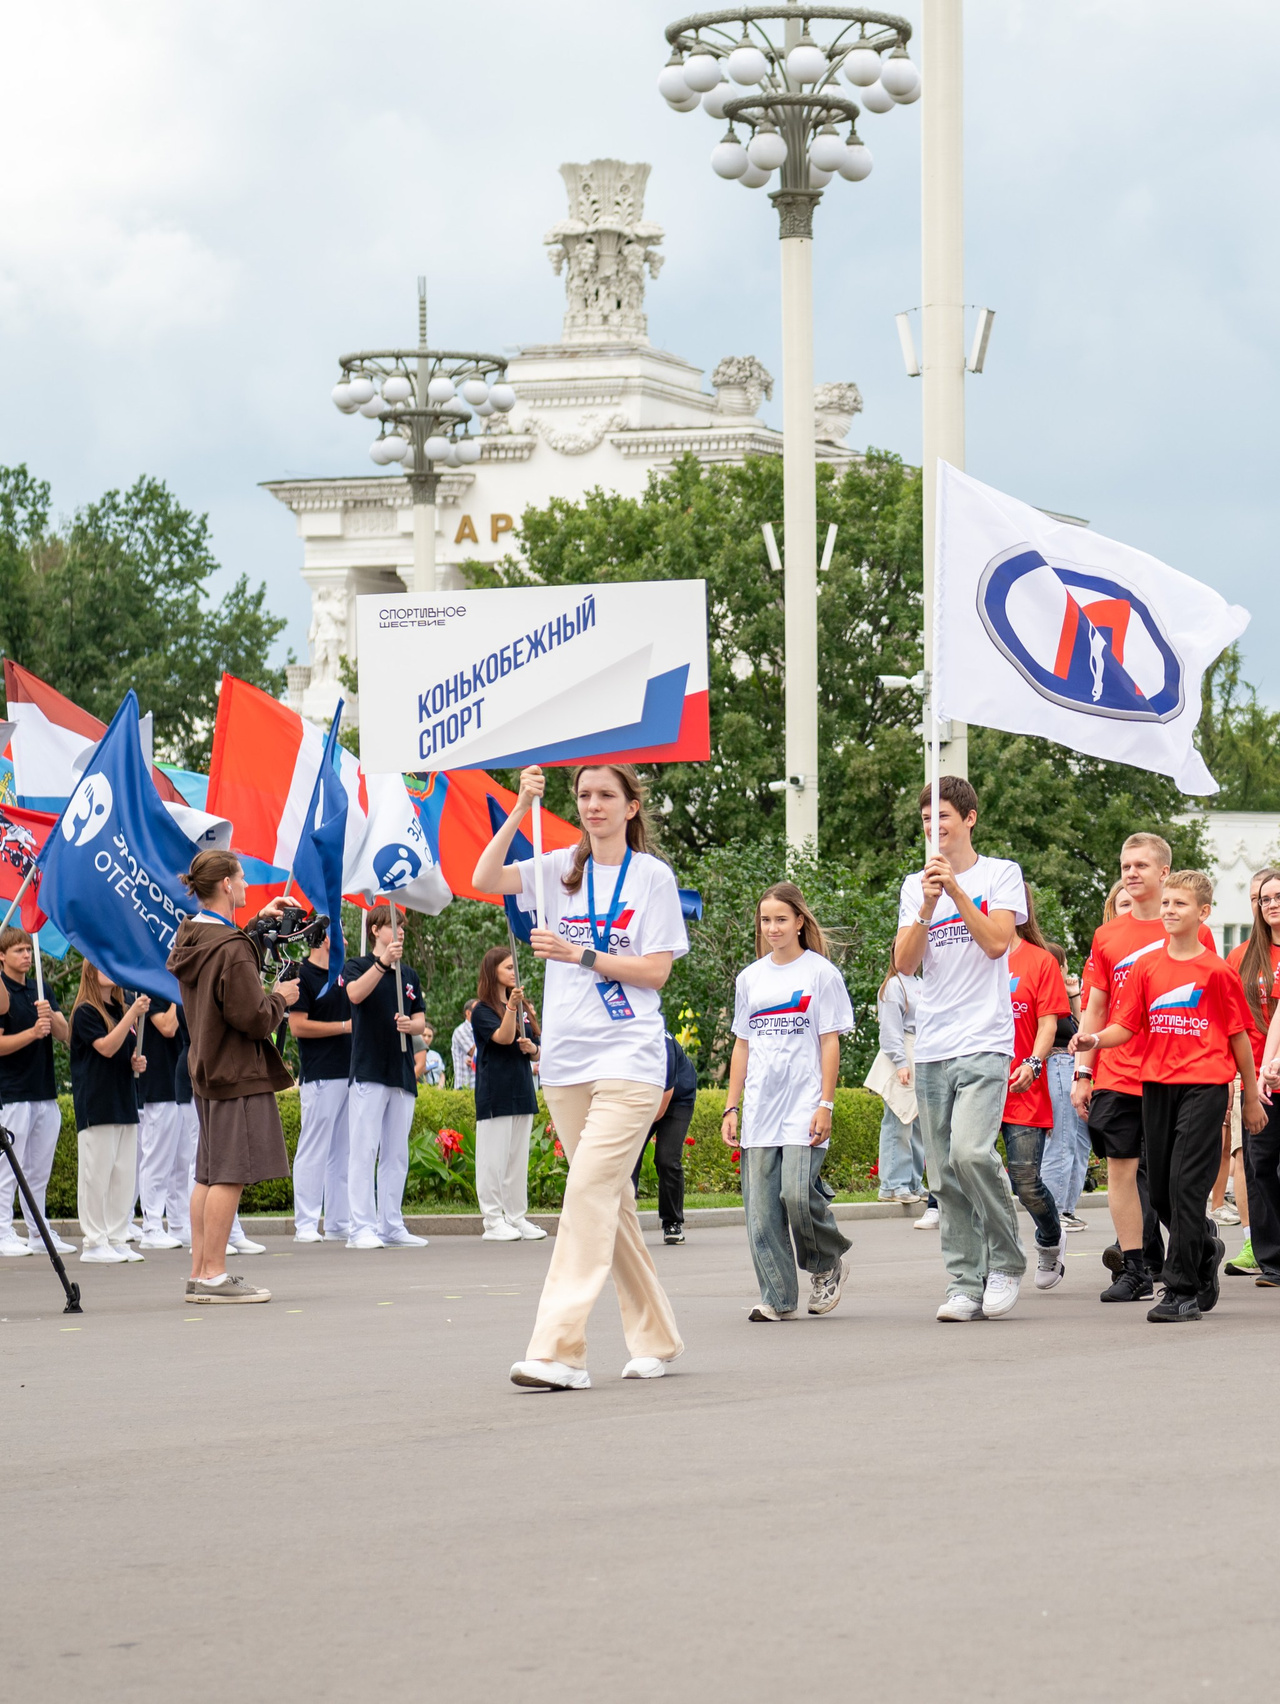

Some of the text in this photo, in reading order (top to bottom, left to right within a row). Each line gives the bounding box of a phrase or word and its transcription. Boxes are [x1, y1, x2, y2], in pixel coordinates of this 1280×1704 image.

[378, 618, 446, 629] ШЕСТВИЕ
[417, 593, 596, 724] КОНЬКОБЕЖНЫЙ
[418, 697, 486, 760] СПОРТ
